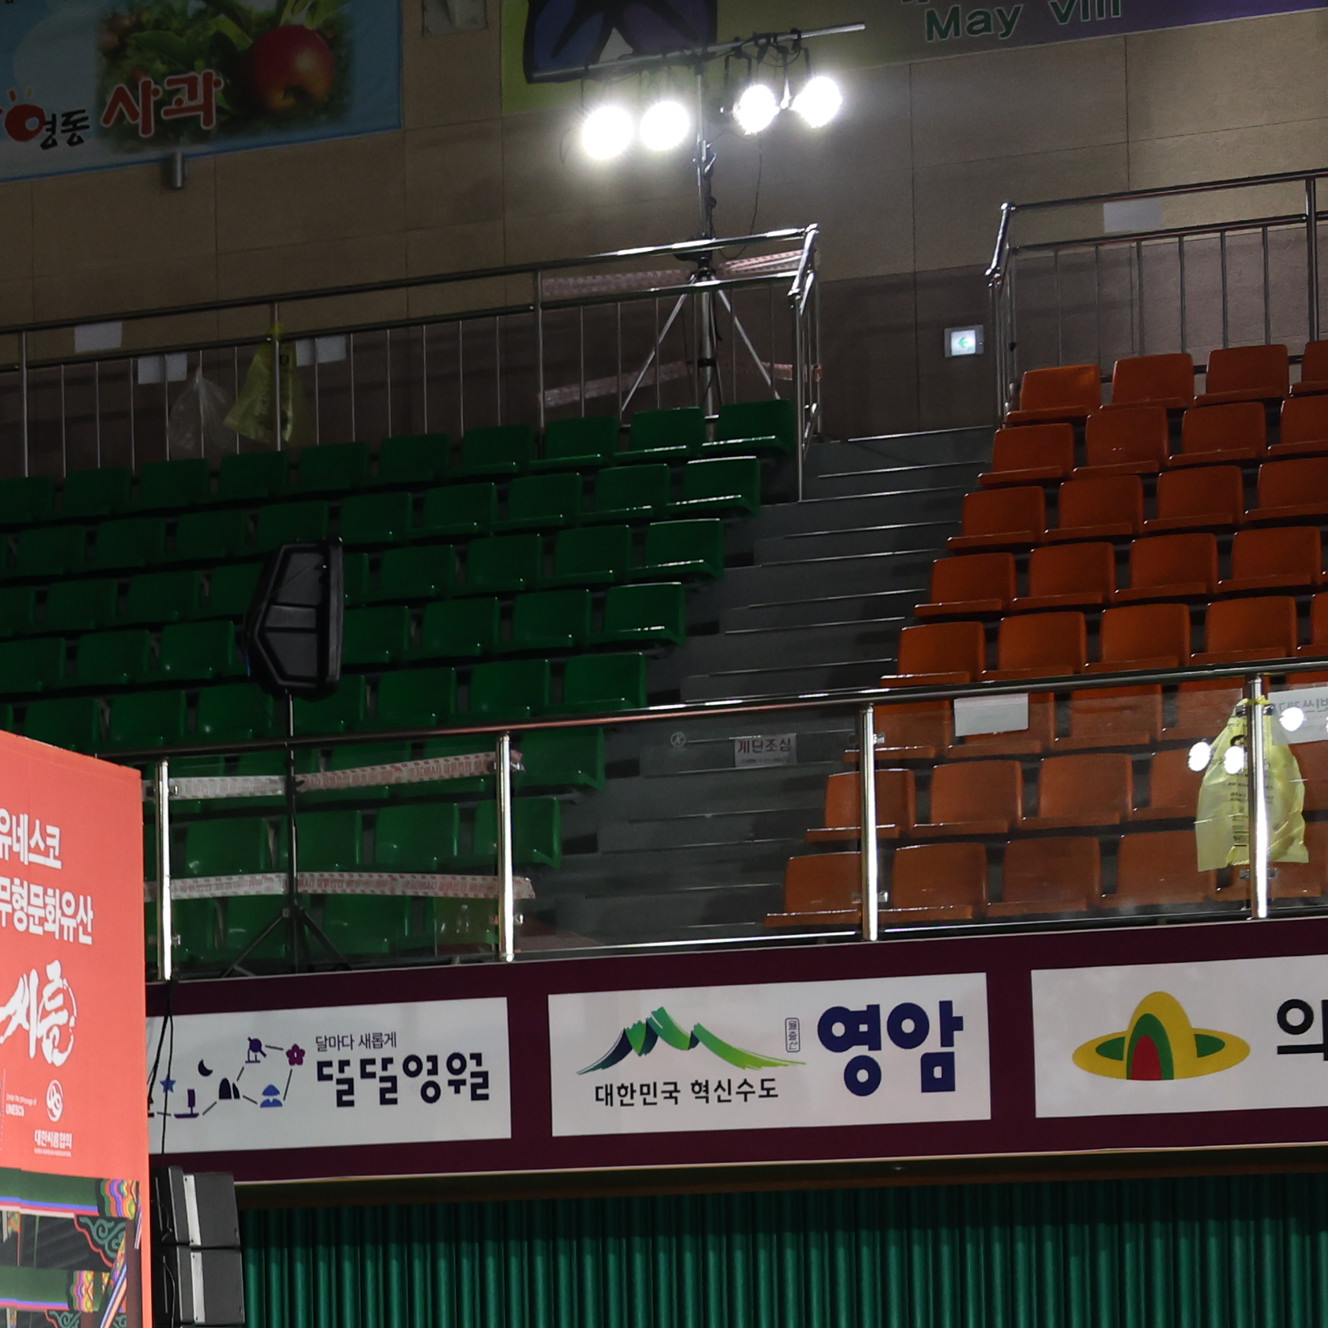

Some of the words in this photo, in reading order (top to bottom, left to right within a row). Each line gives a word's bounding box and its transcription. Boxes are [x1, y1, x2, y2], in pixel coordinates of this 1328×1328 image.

[925, 5, 1024, 43] May
[100, 70, 224, 137] 사과
[738, 738, 791, 754] 계단조심
[315, 1034, 354, 1053] 달마다
[358, 1031, 398, 1050] 새롭게
[817, 1000, 965, 1098] 영암
[594, 1082, 682, 1108] 대한민국
[690, 1077, 780, 1106] 혁신수도
